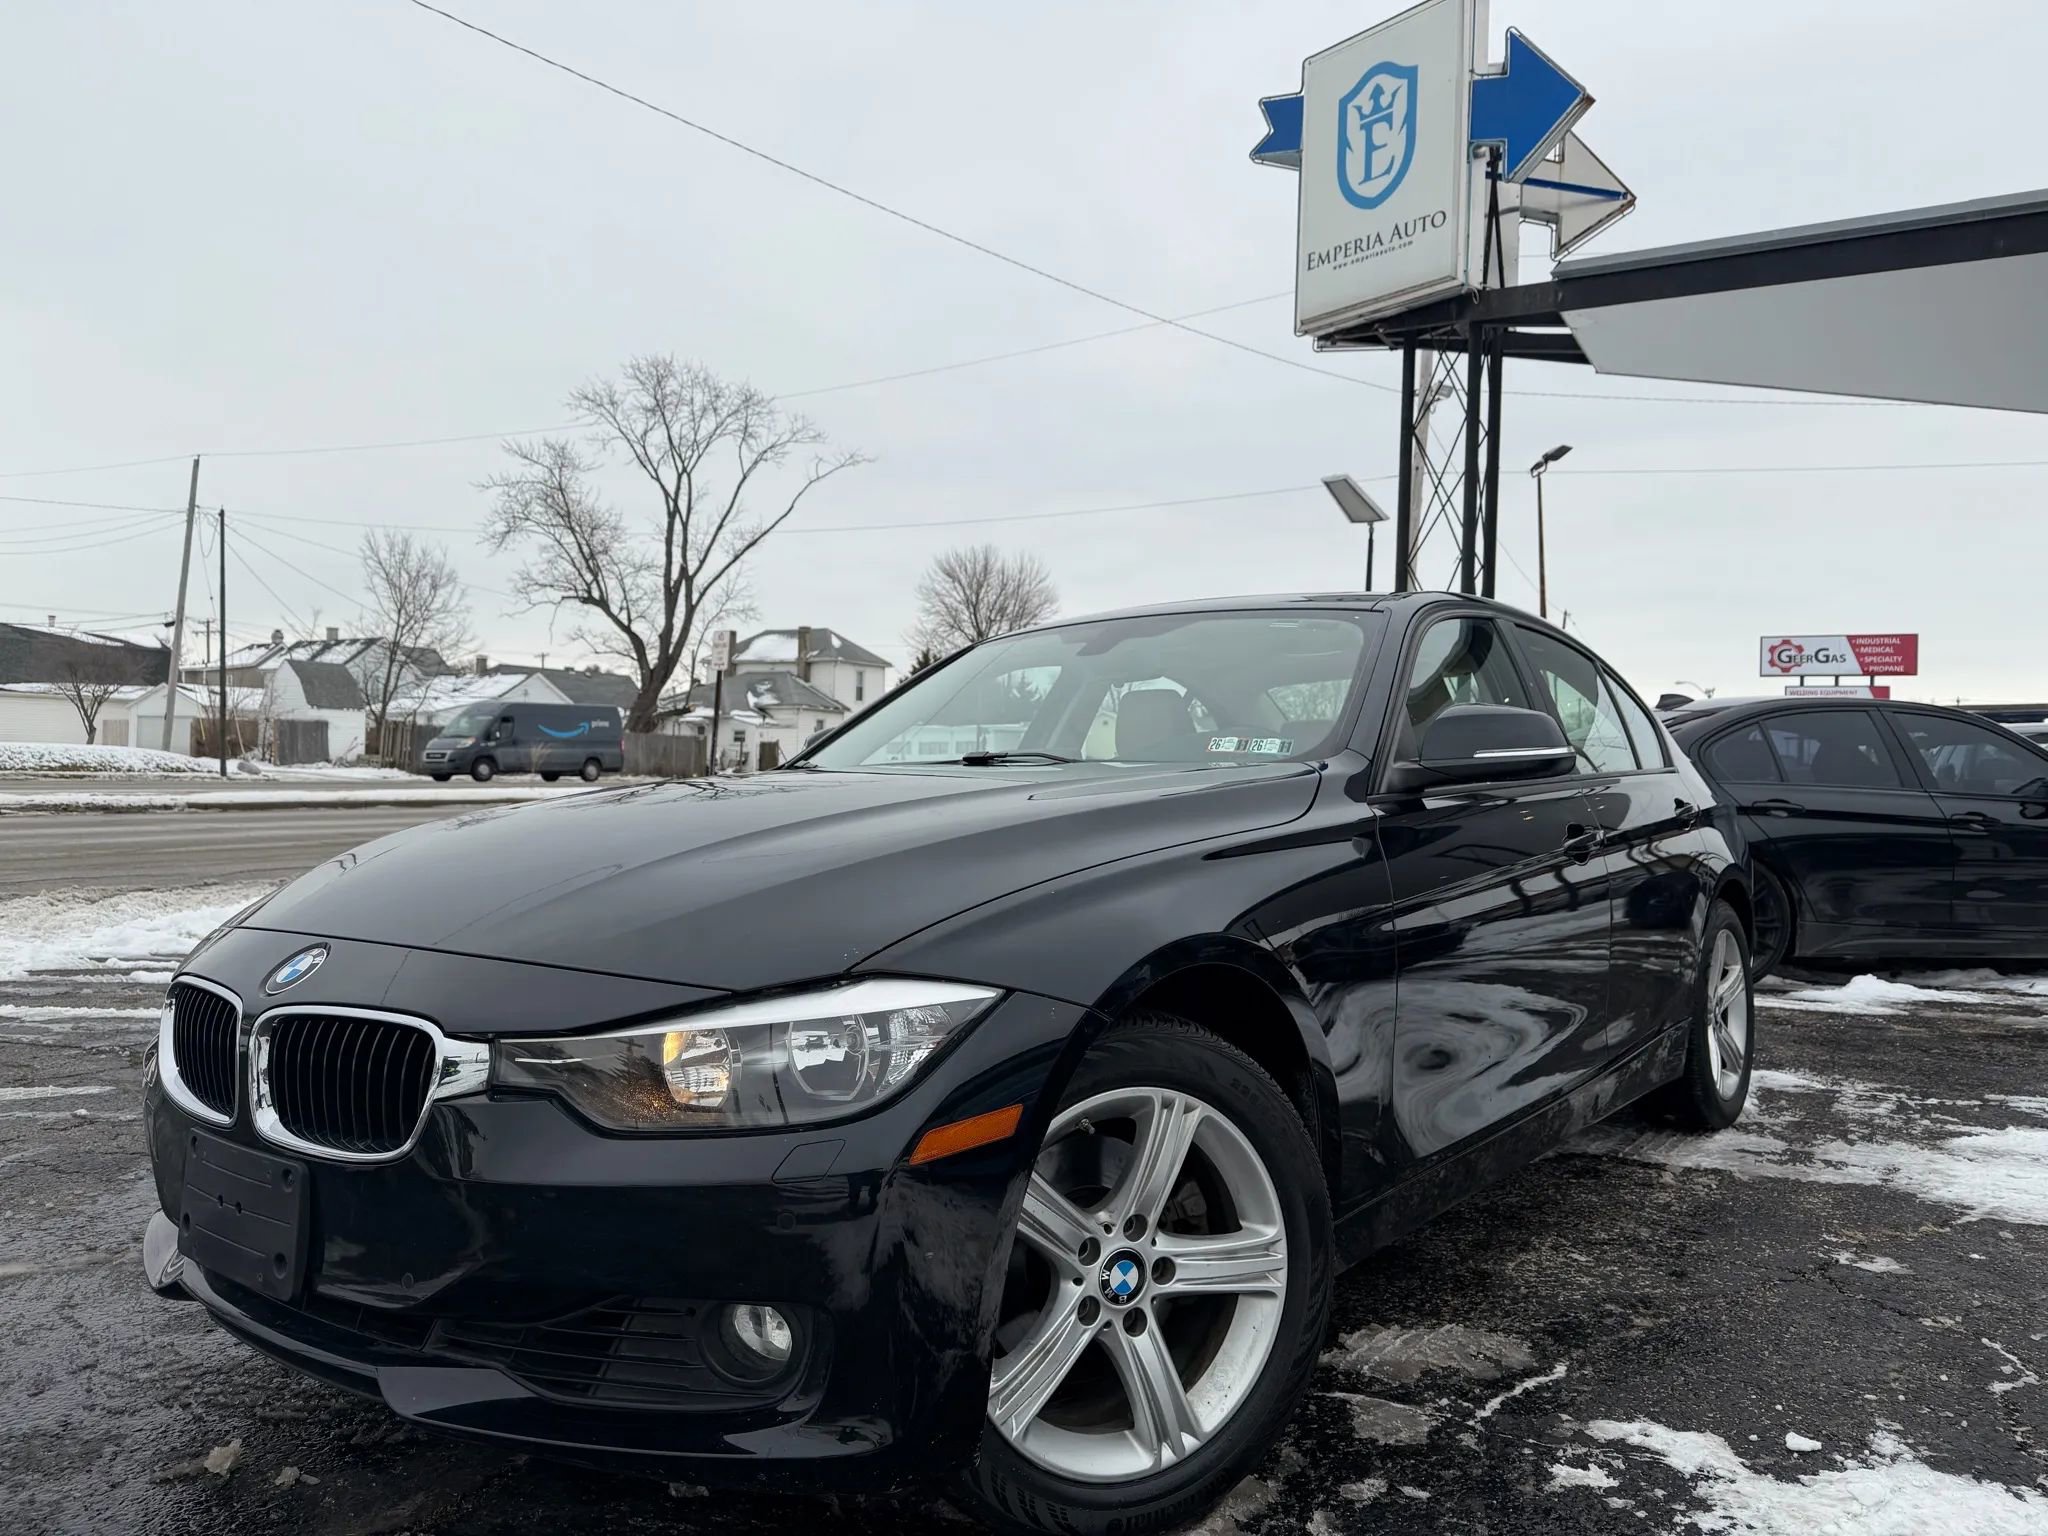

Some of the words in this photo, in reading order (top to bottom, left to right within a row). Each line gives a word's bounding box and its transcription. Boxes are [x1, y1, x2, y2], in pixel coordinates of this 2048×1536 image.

[1306, 231, 1384, 272] EMPERIA
[1389, 210, 1447, 244] AUTO
[1856, 637, 1901, 645] INDUSTRIAL
[1860, 646, 1894, 654] MEDICAL
[1864, 655, 1903, 663] SPECIALTY
[1869, 665, 1905, 673] PROPANE
[1209, 738, 1223, 750] 26
[1251, 739, 1264, 751] 26
